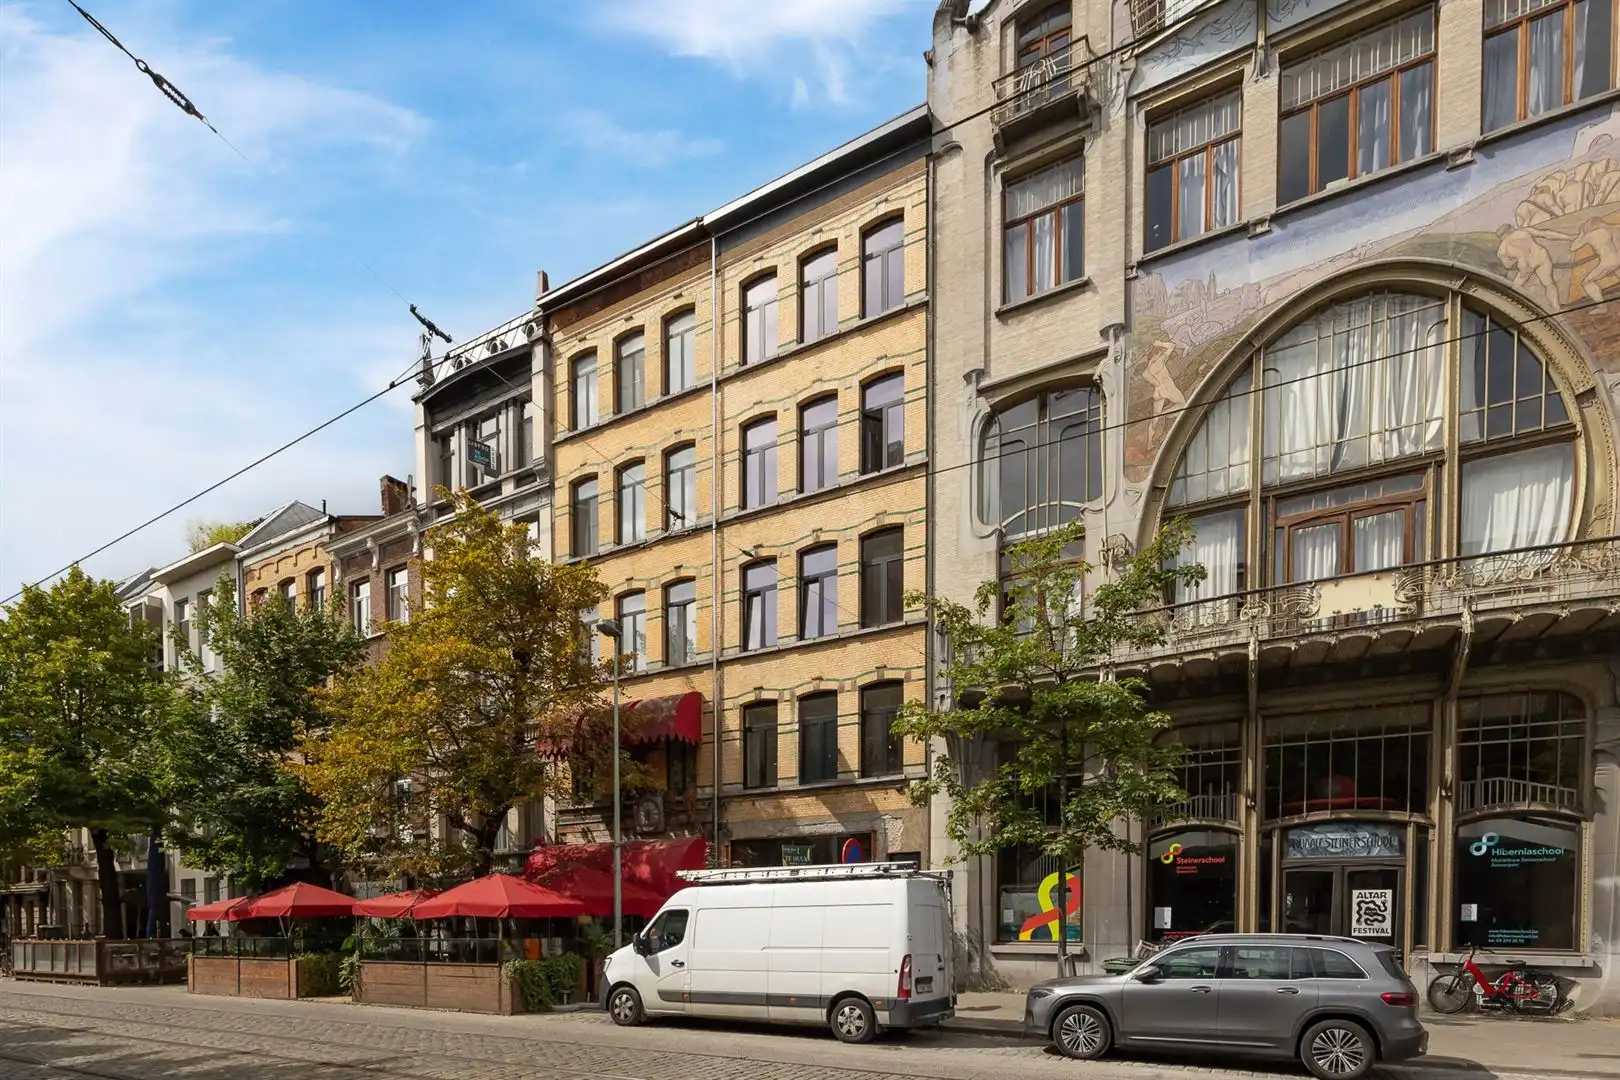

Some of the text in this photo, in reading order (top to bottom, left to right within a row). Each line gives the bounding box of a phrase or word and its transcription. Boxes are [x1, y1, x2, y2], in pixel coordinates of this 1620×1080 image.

[1491, 847, 1564, 856] Hiberniaschool
[1176, 855, 1225, 864] Steinerschool
[1356, 891, 1387, 899] ALTAR
